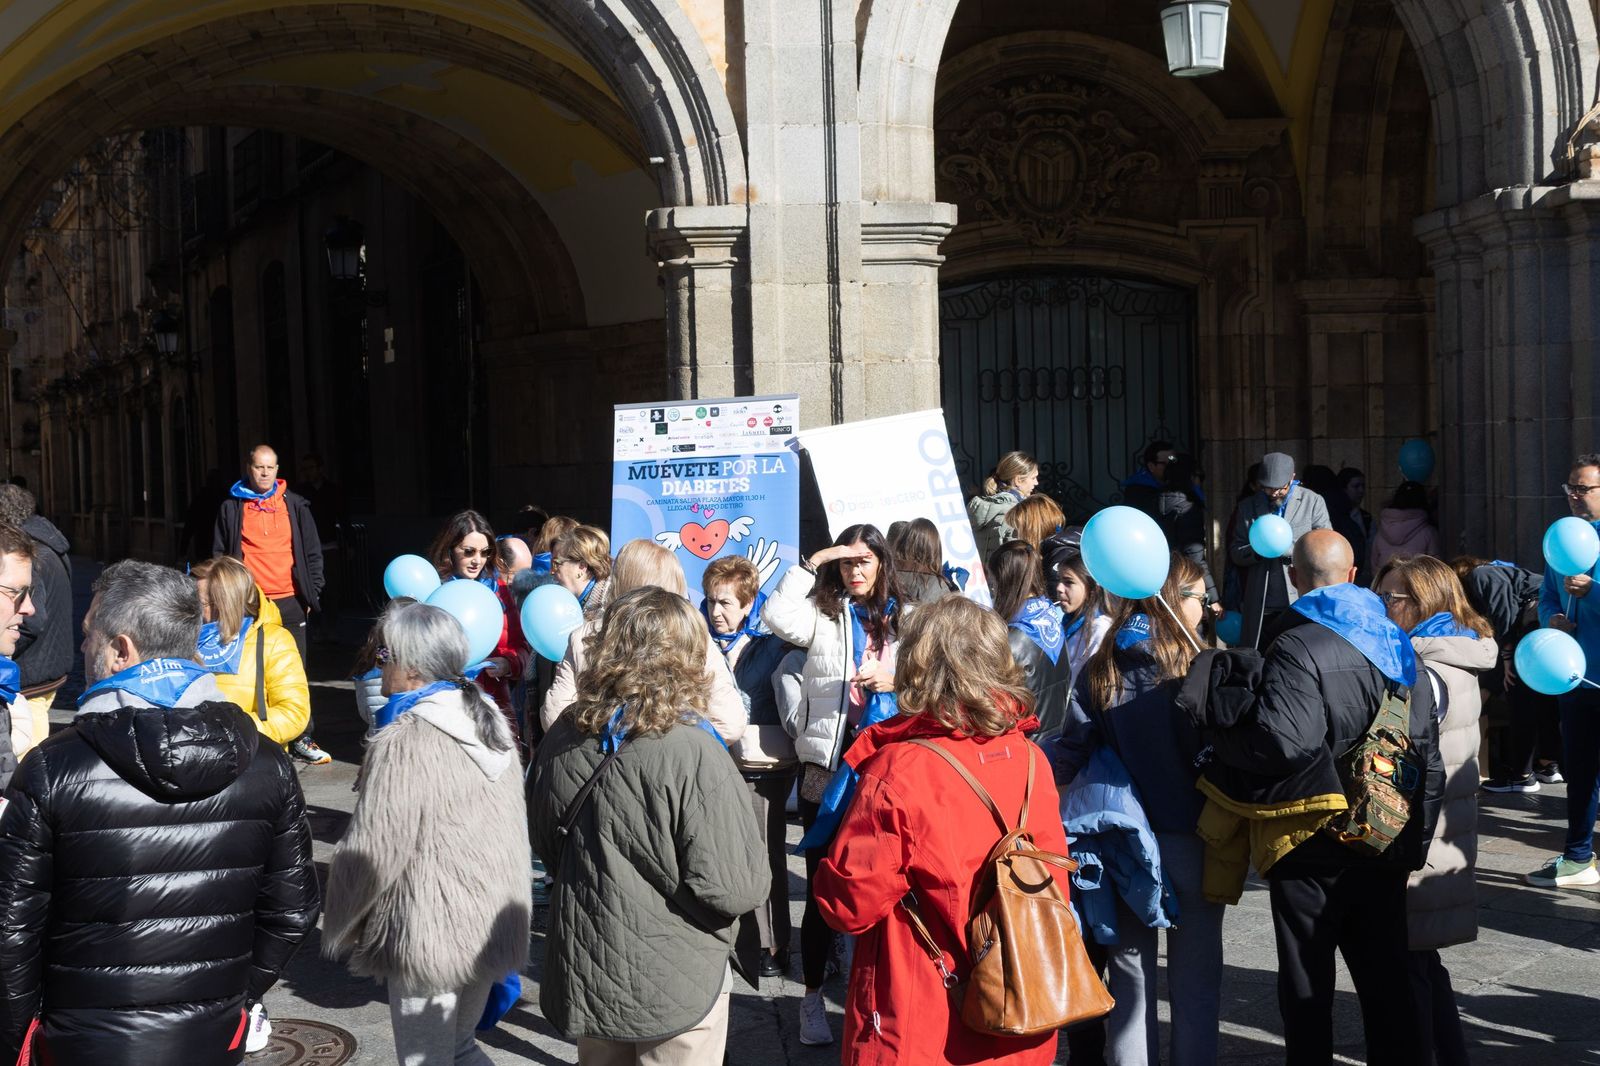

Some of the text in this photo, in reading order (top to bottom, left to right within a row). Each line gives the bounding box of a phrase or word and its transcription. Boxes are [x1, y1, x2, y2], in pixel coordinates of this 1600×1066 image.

[628, 458, 786, 480] MUÉVETE POR LA
[661, 478, 750, 496] DIABETES
[722, 495, 744, 503] MAYOR
